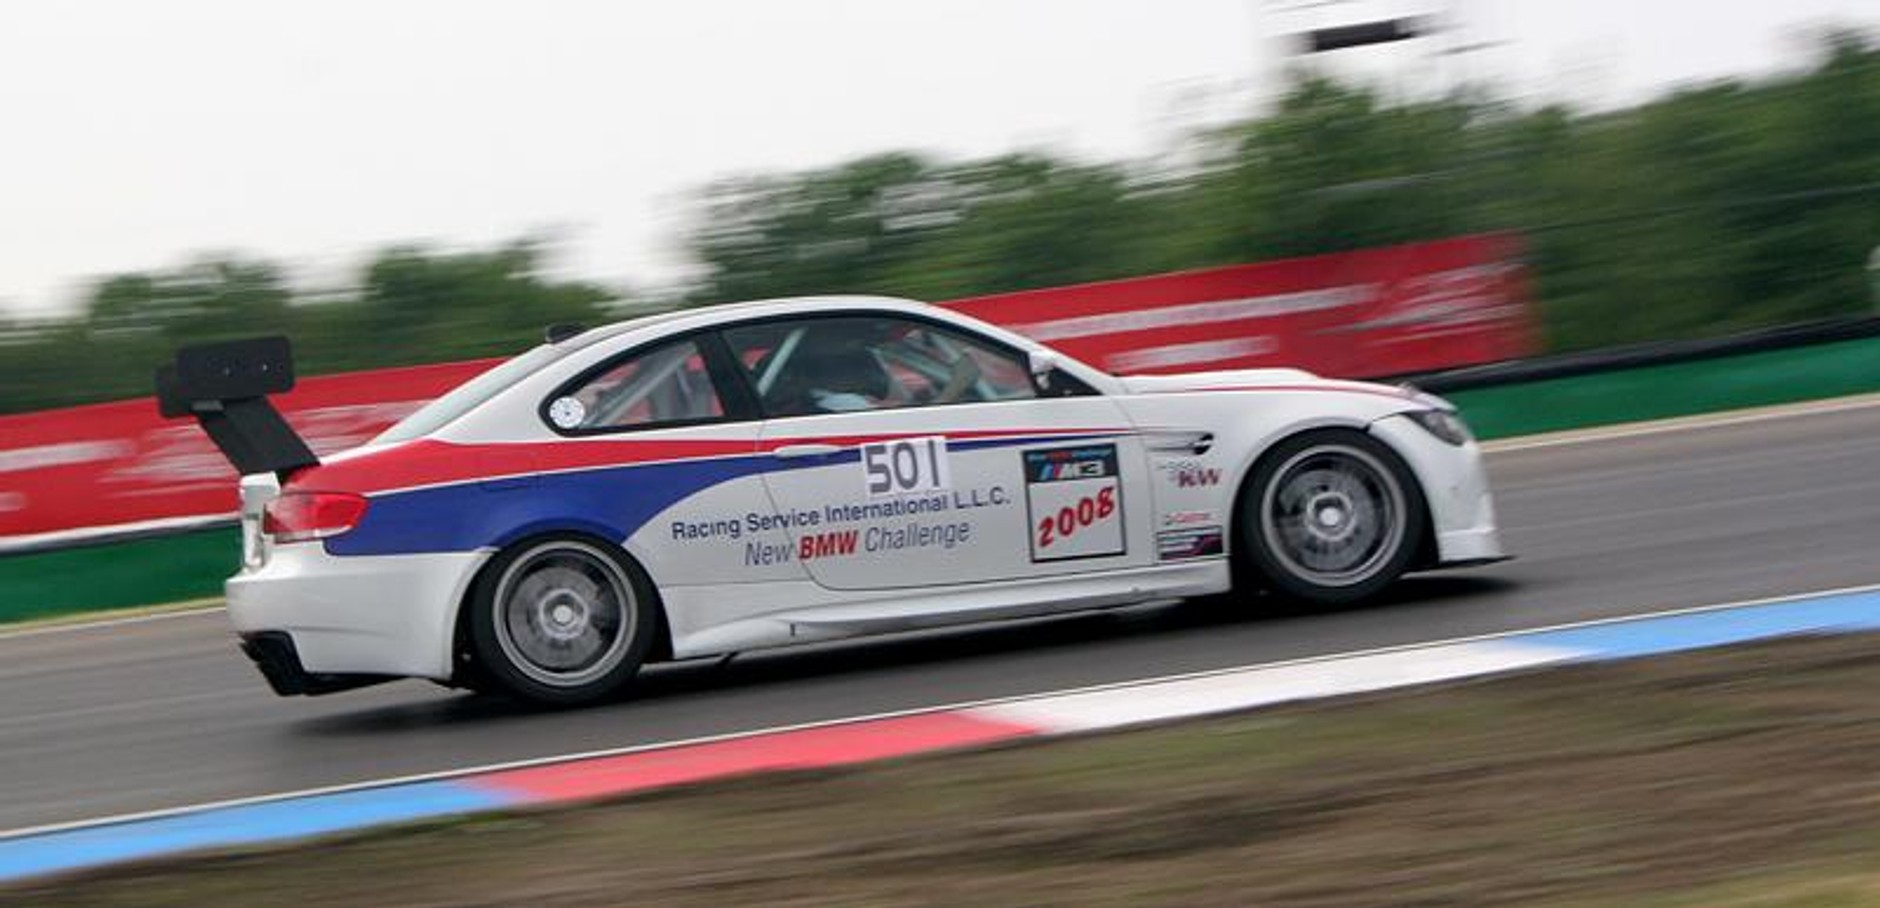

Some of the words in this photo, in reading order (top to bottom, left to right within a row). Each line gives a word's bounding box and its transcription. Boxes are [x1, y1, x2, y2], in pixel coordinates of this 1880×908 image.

[864, 440, 940, 494] 501
[671, 519, 741, 539] Racing
[746, 512, 820, 532] Service
[825, 493, 949, 522] International
[954, 486, 1012, 508] L.L.C.
[1038, 486, 1116, 547] 2008
[744, 542, 793, 566] New
[799, 530, 859, 559] BMW
[864, 522, 971, 551] Challenge
